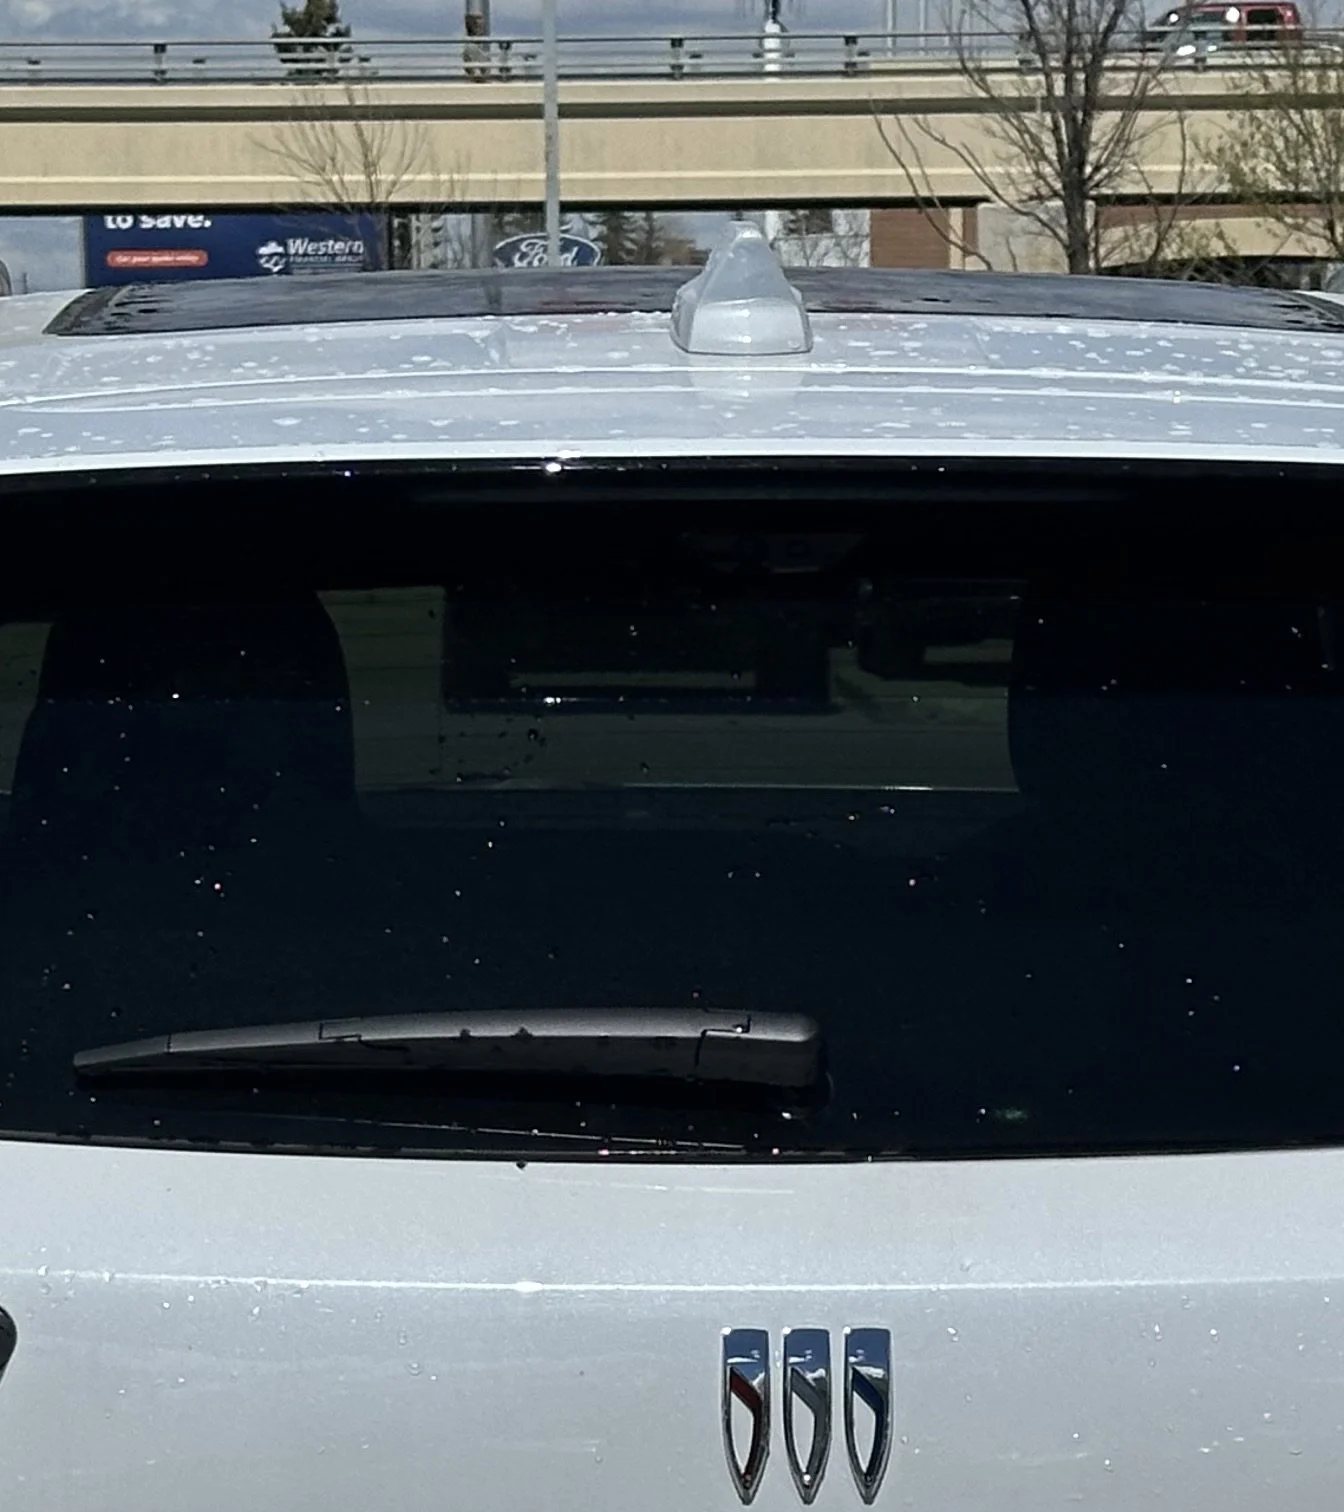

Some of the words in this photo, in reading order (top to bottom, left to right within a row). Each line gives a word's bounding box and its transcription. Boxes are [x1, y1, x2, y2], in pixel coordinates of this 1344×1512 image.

[138, 214, 212, 229] save.
[286, 237, 364, 255] Western
[513, 239, 578, 267] Fod
